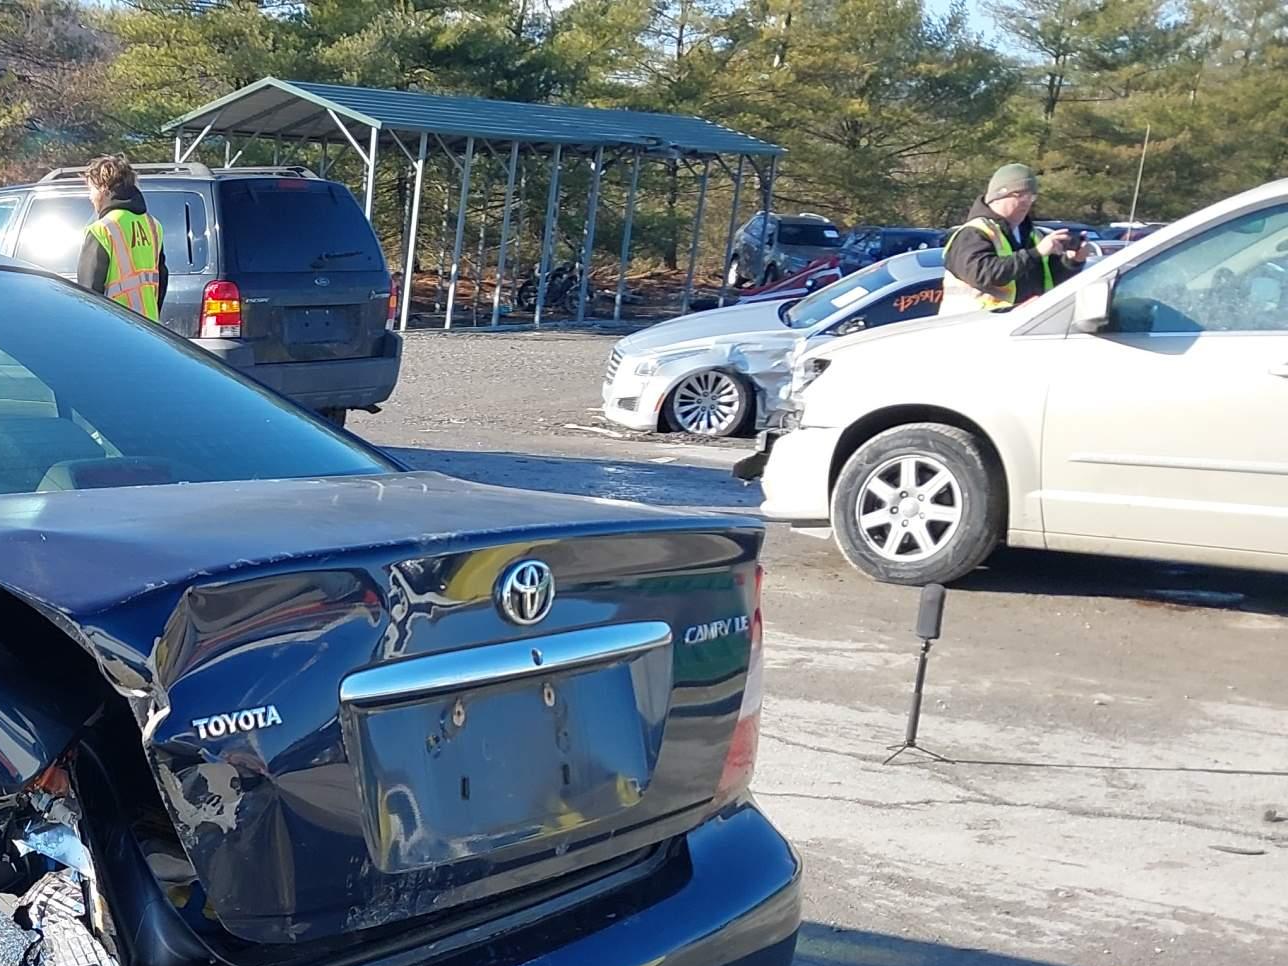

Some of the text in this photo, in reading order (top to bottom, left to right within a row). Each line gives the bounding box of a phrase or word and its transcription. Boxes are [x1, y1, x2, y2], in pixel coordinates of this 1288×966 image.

[684, 615, 749, 644] CAMRY LE
[192, 704, 282, 739] TOYOTA
